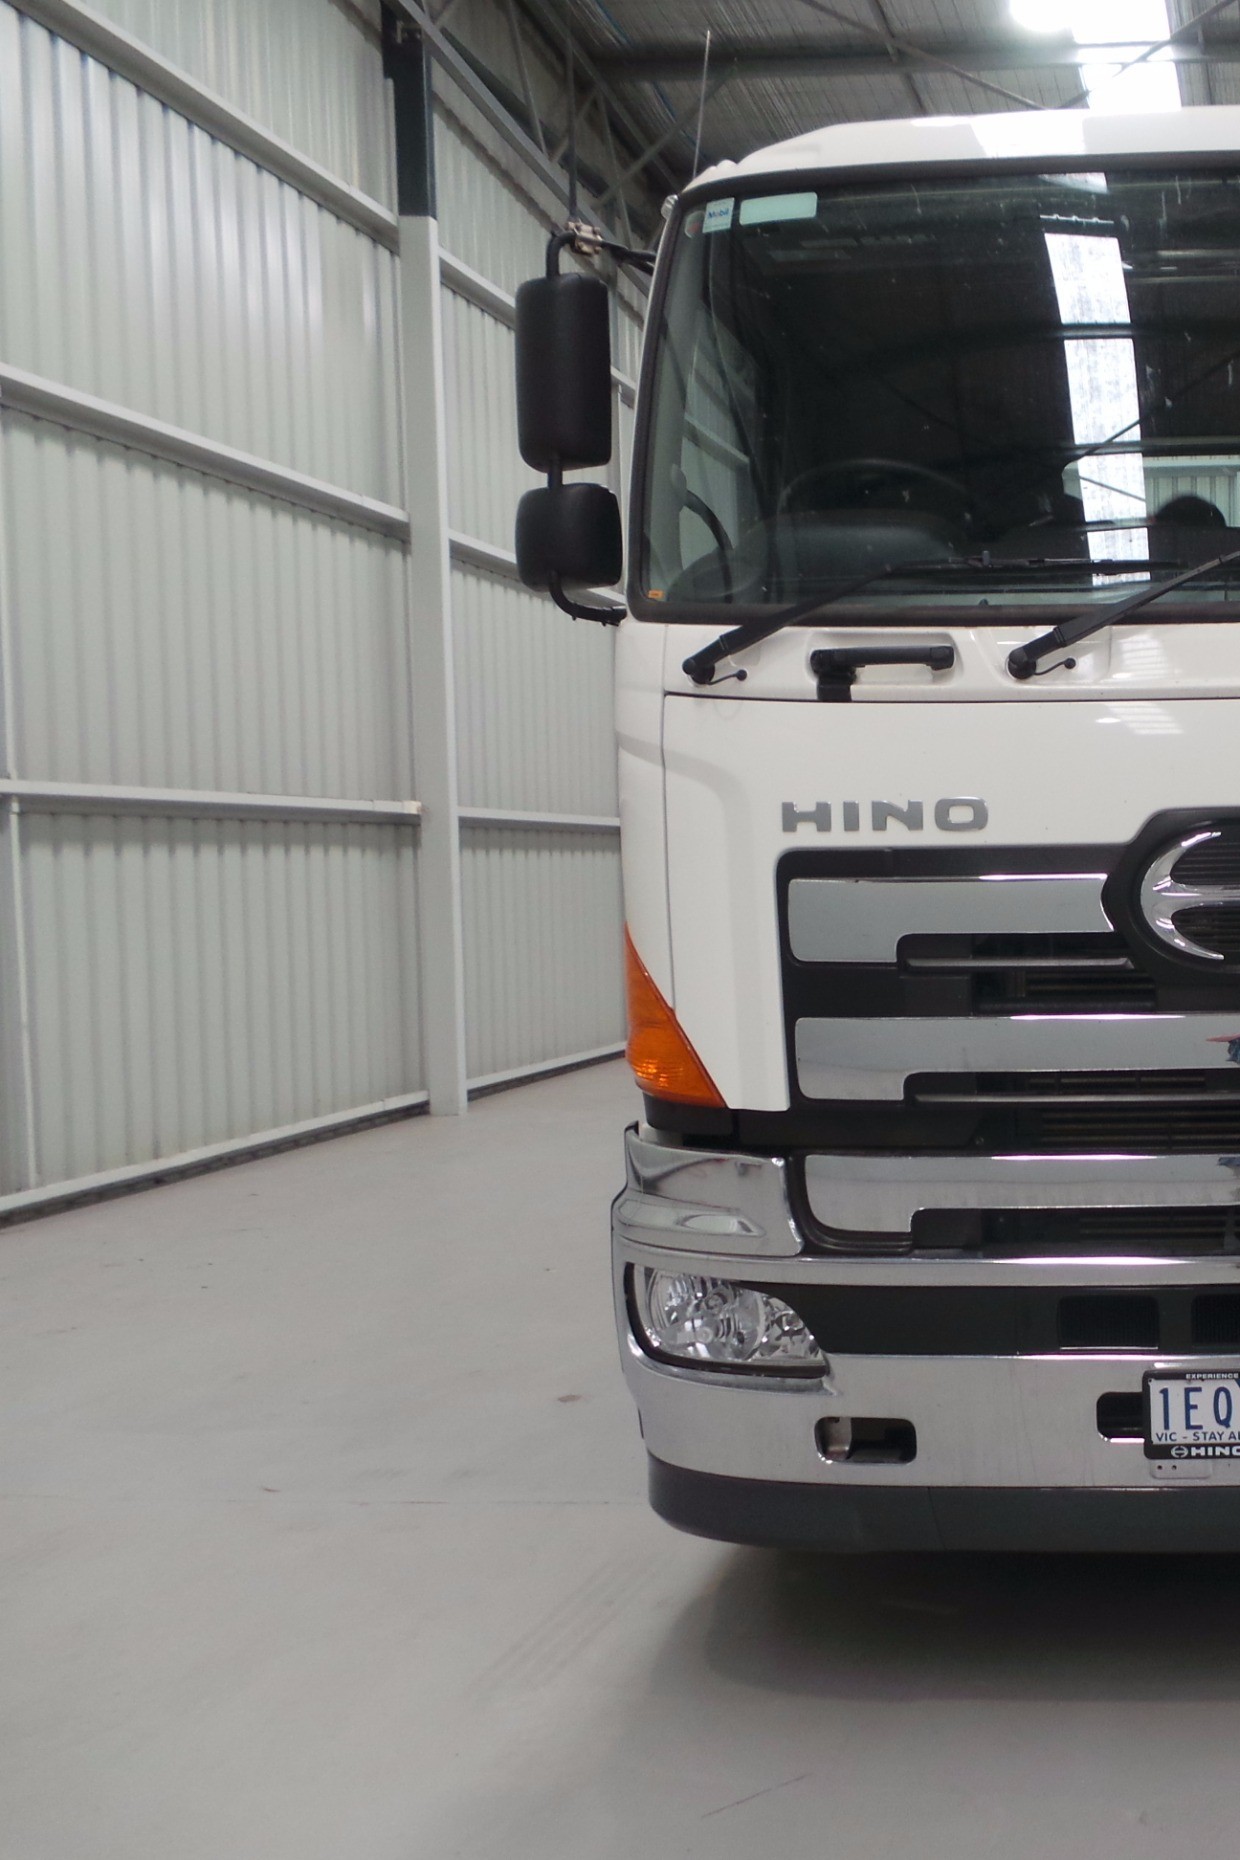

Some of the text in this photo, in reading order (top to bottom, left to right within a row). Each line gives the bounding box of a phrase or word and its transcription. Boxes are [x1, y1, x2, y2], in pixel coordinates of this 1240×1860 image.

[782, 797, 988, 832] HINO
[1159, 1386, 1233, 1430] 1EQ
[1156, 1432, 1177, 1442] VIC
[1193, 1431, 1224, 1441] STAY
